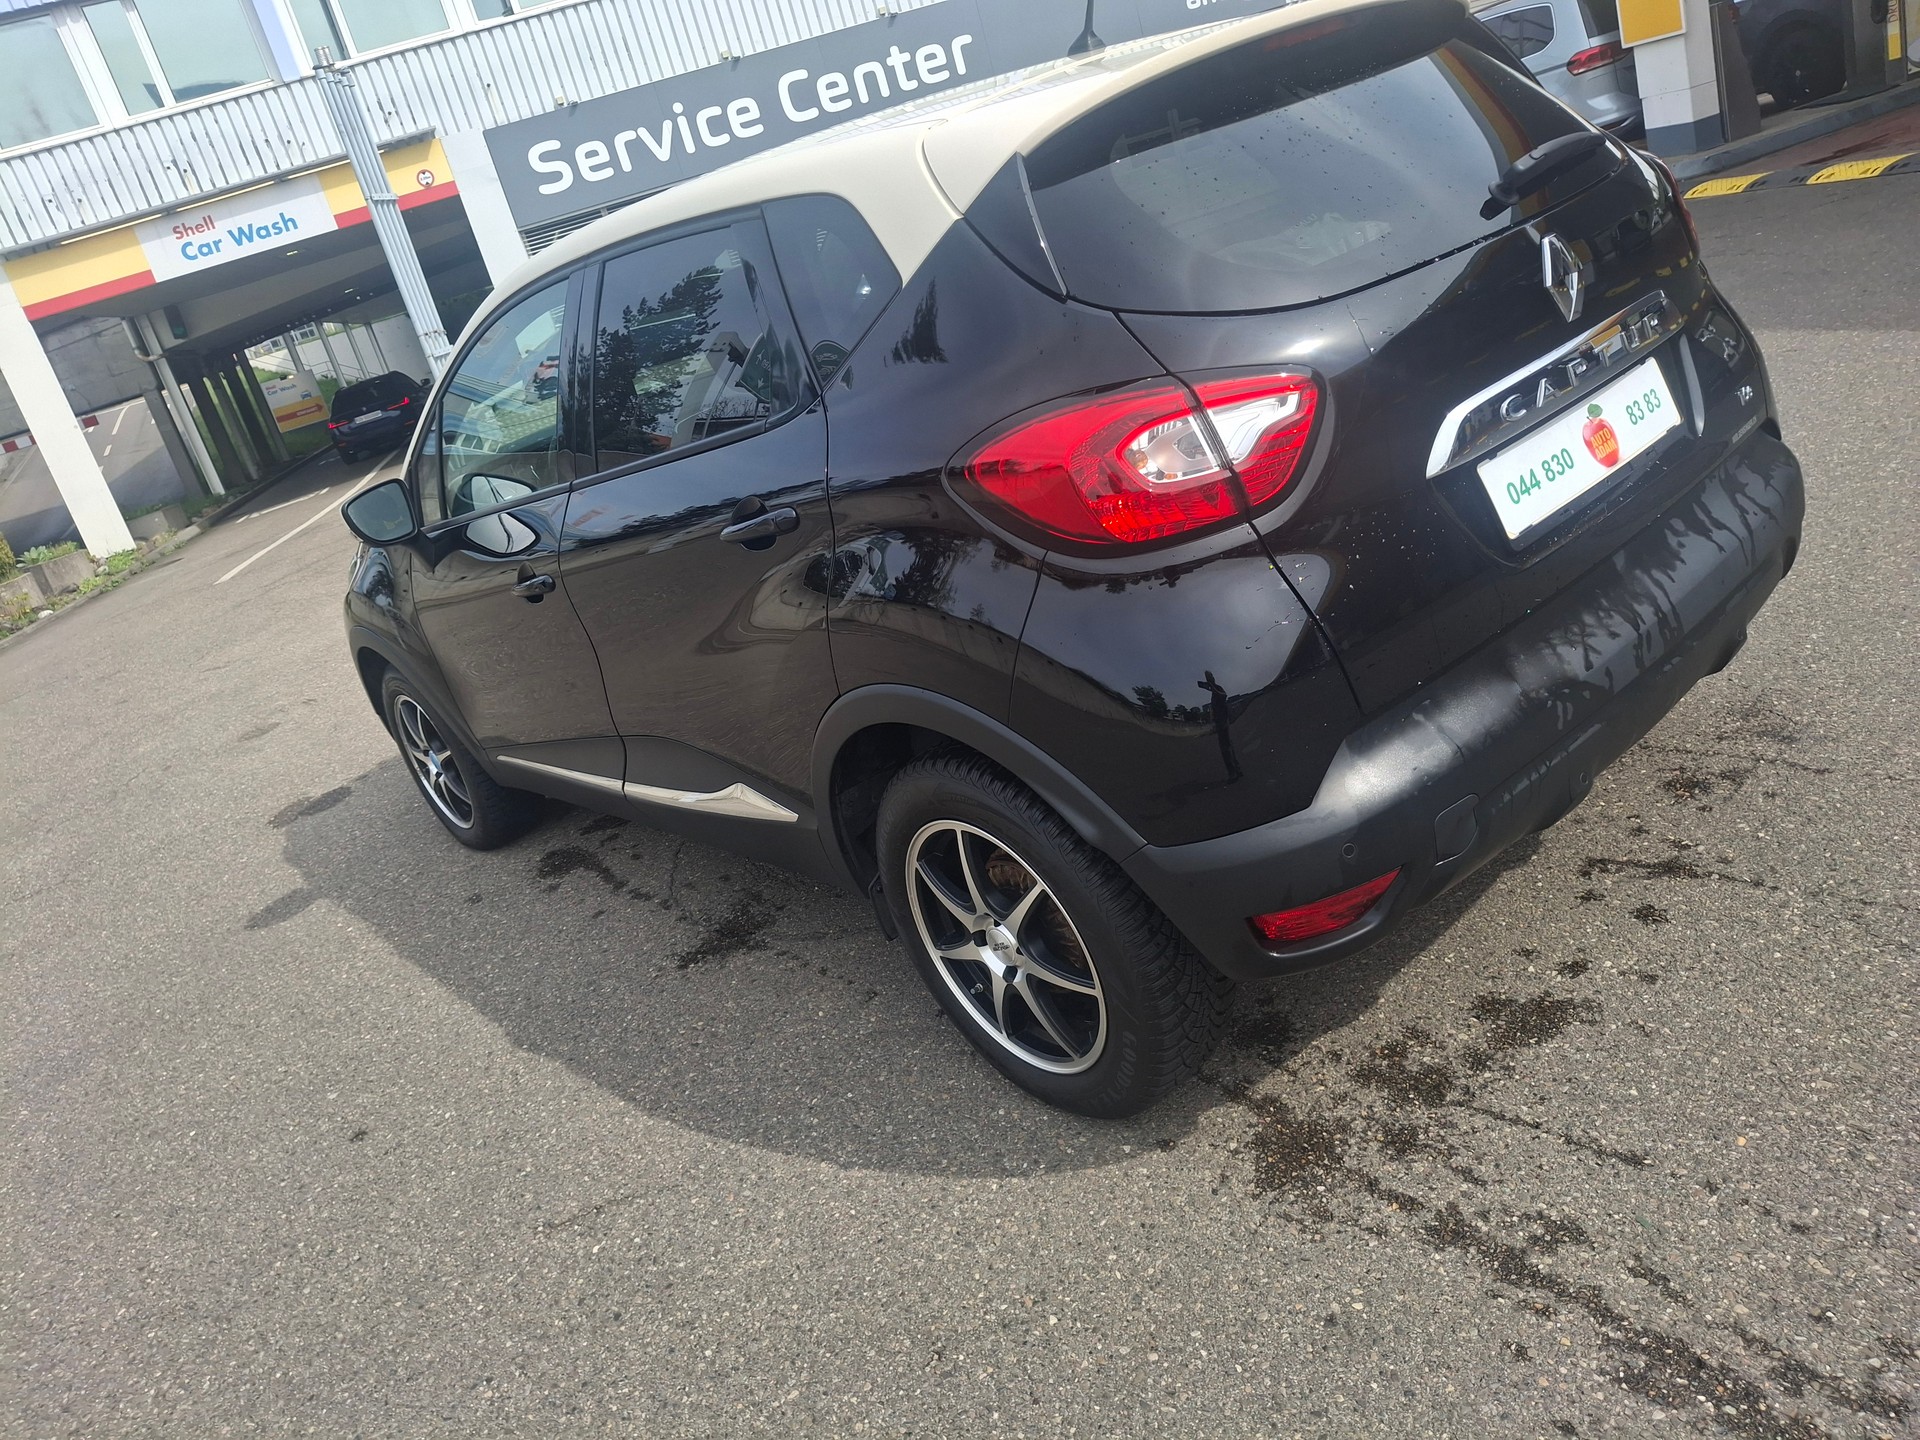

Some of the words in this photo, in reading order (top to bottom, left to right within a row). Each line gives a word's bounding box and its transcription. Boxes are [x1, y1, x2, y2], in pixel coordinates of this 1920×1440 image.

[527, 101, 764, 195] Service
[777, 34, 973, 122] Center
[172, 215, 216, 240] Shell
[180, 237, 223, 261] Car
[227, 212, 299, 246] Wash
[1500, 313, 1663, 422] CAPTUR
[1506, 468, 1541, 505] 044
[1541, 448, 1575, 482] 830
[1625, 400, 1645, 425] 83
[1643, 388, 1661, 413] 83
[1590, 427, 1612, 449] AUTO
[1595, 438, 1618, 460] ADAM
